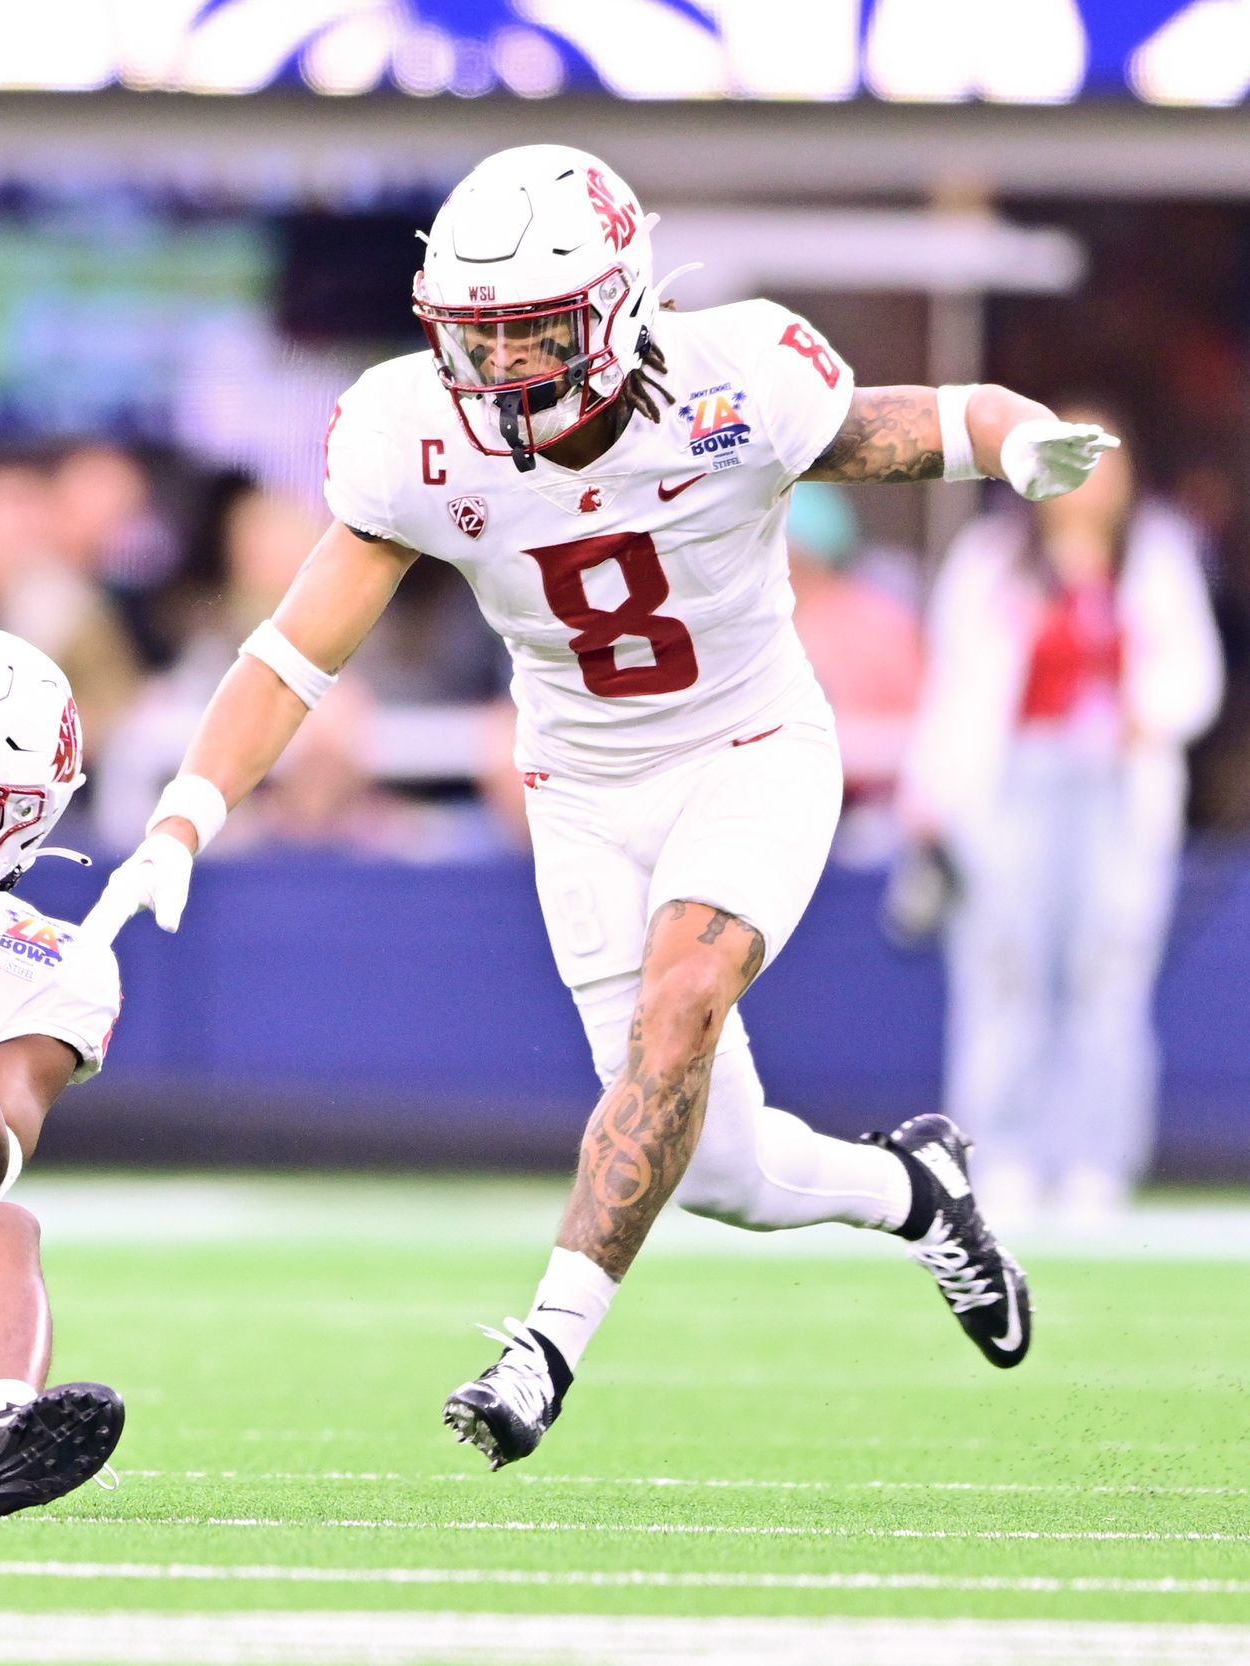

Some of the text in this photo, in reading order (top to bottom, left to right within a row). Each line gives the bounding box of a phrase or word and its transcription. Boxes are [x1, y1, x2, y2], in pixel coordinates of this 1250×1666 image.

[468, 285, 496, 301] WSU
[777, 323, 840, 390] 8
[690, 395, 744, 440] LA
[691, 433, 749, 457] BOWL
[420, 438, 447, 485] C
[712, 457, 742, 471] STIFEL
[448, 497, 486, 524] PAC
[460, 513, 482, 532] 12
[519, 531, 699, 697] 8
[5, 918, 60, 954] LA
